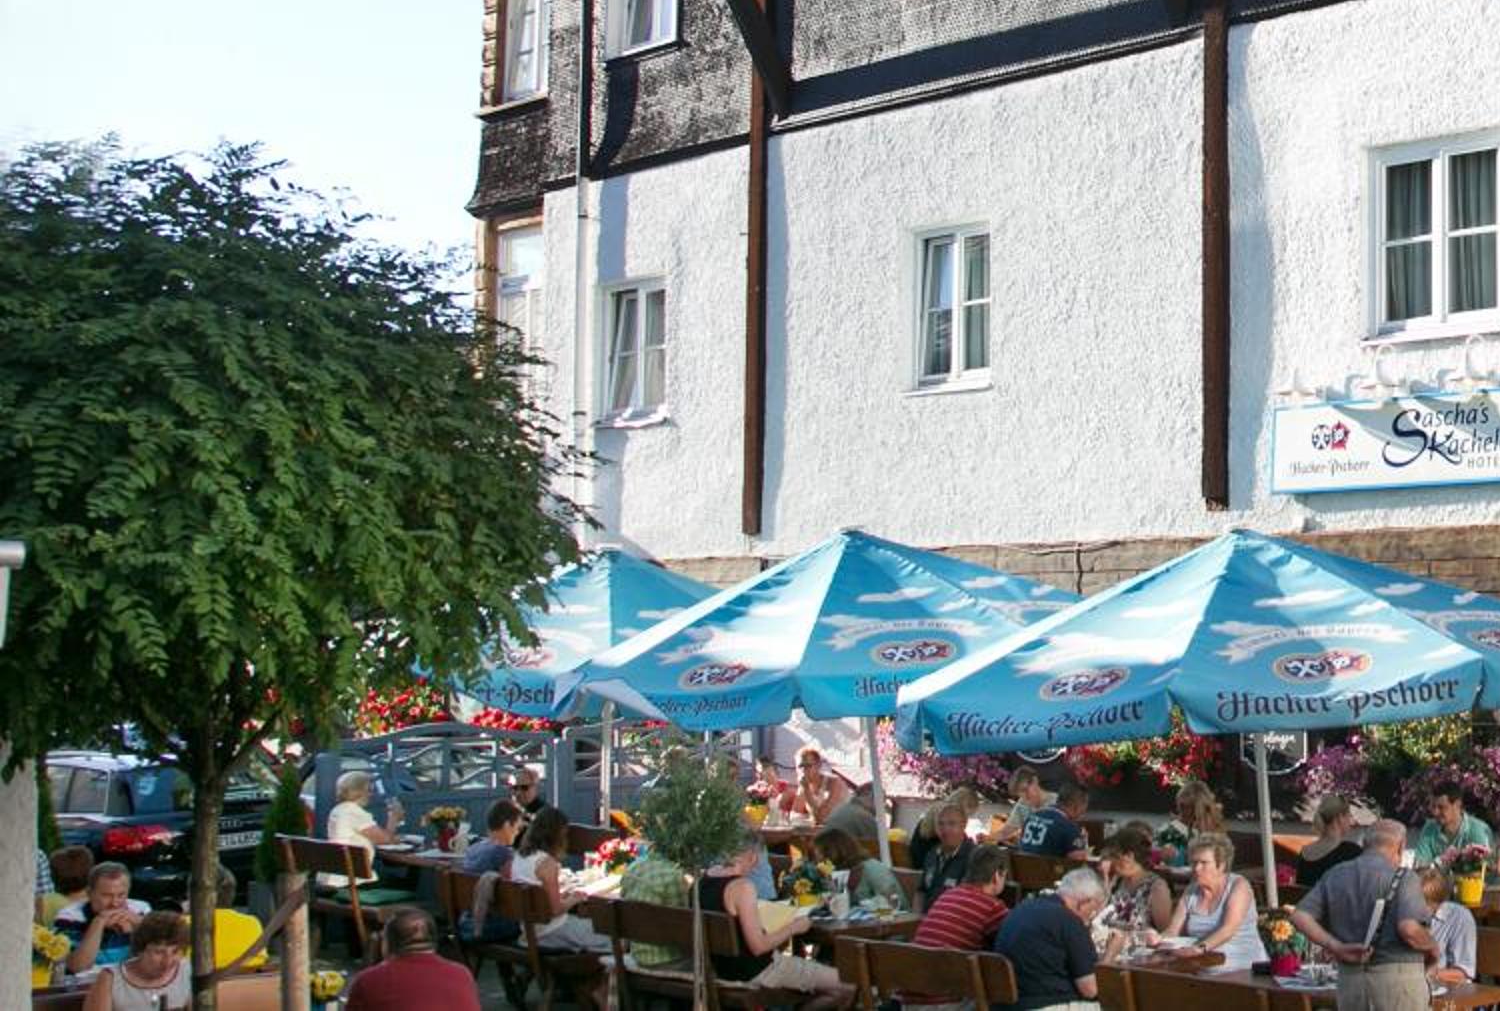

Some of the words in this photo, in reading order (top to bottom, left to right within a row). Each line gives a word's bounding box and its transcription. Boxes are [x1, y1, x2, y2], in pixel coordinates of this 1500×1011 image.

[1382, 401, 1490, 468] Sascha's
[947, 700, 1145, 741] Hacker-Pschorr
[1216, 678, 1460, 723] Hacker-Pschorr
